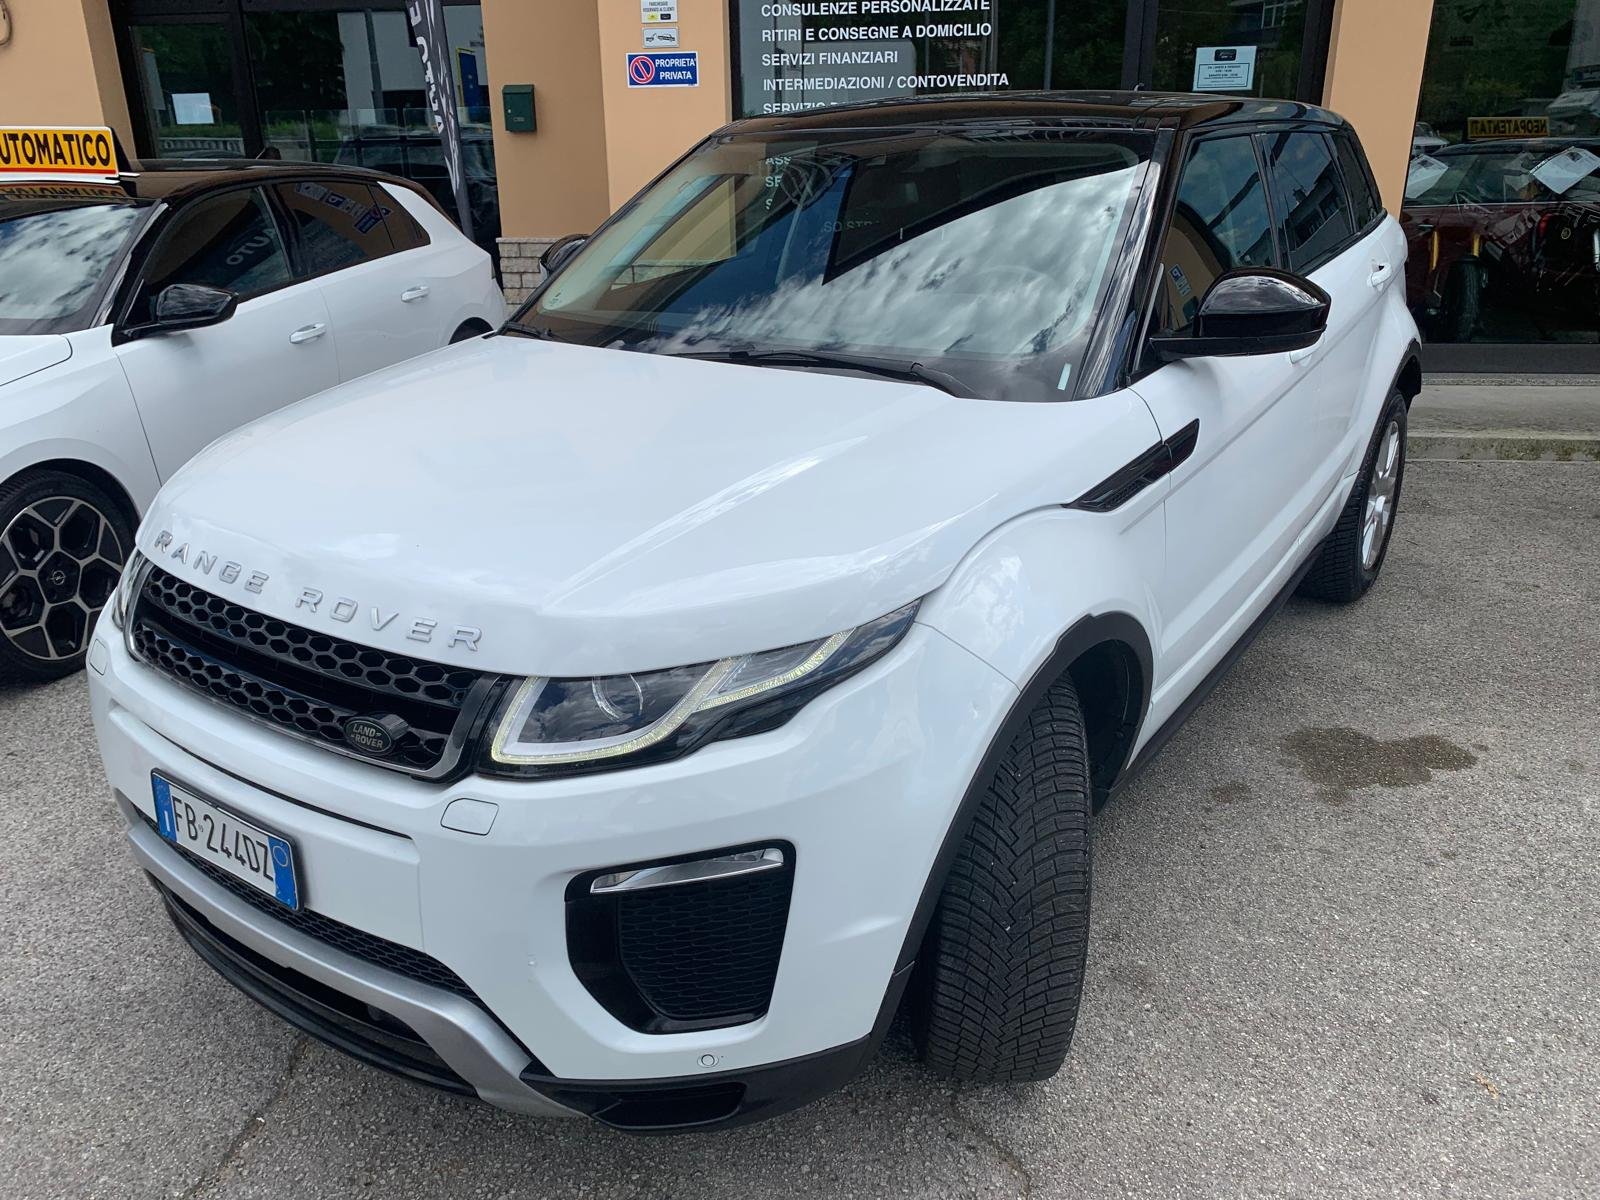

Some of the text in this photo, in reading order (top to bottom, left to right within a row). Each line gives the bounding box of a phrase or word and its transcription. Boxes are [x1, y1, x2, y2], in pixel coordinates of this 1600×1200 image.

[761, 0, 990, 17] CONSULENZE PERSONALIZZATE
[762, 23, 992, 42] RITIRI E CONSEGNE A DOMICILIO
[762, 51, 898, 66] SERVIZI FINANZIARI
[660, 71, 692, 80] PRIVATA
[763, 77, 885, 91] INTERMEDIAZIONI
[896, 73, 1009, 89] CONTOVENDITA
[154, 530, 482, 651] RANGE ROVER
[353, 724, 376, 737] LAND
[355, 734, 384, 749] ROVER
[171, 795, 274, 881] FB 244DZ
